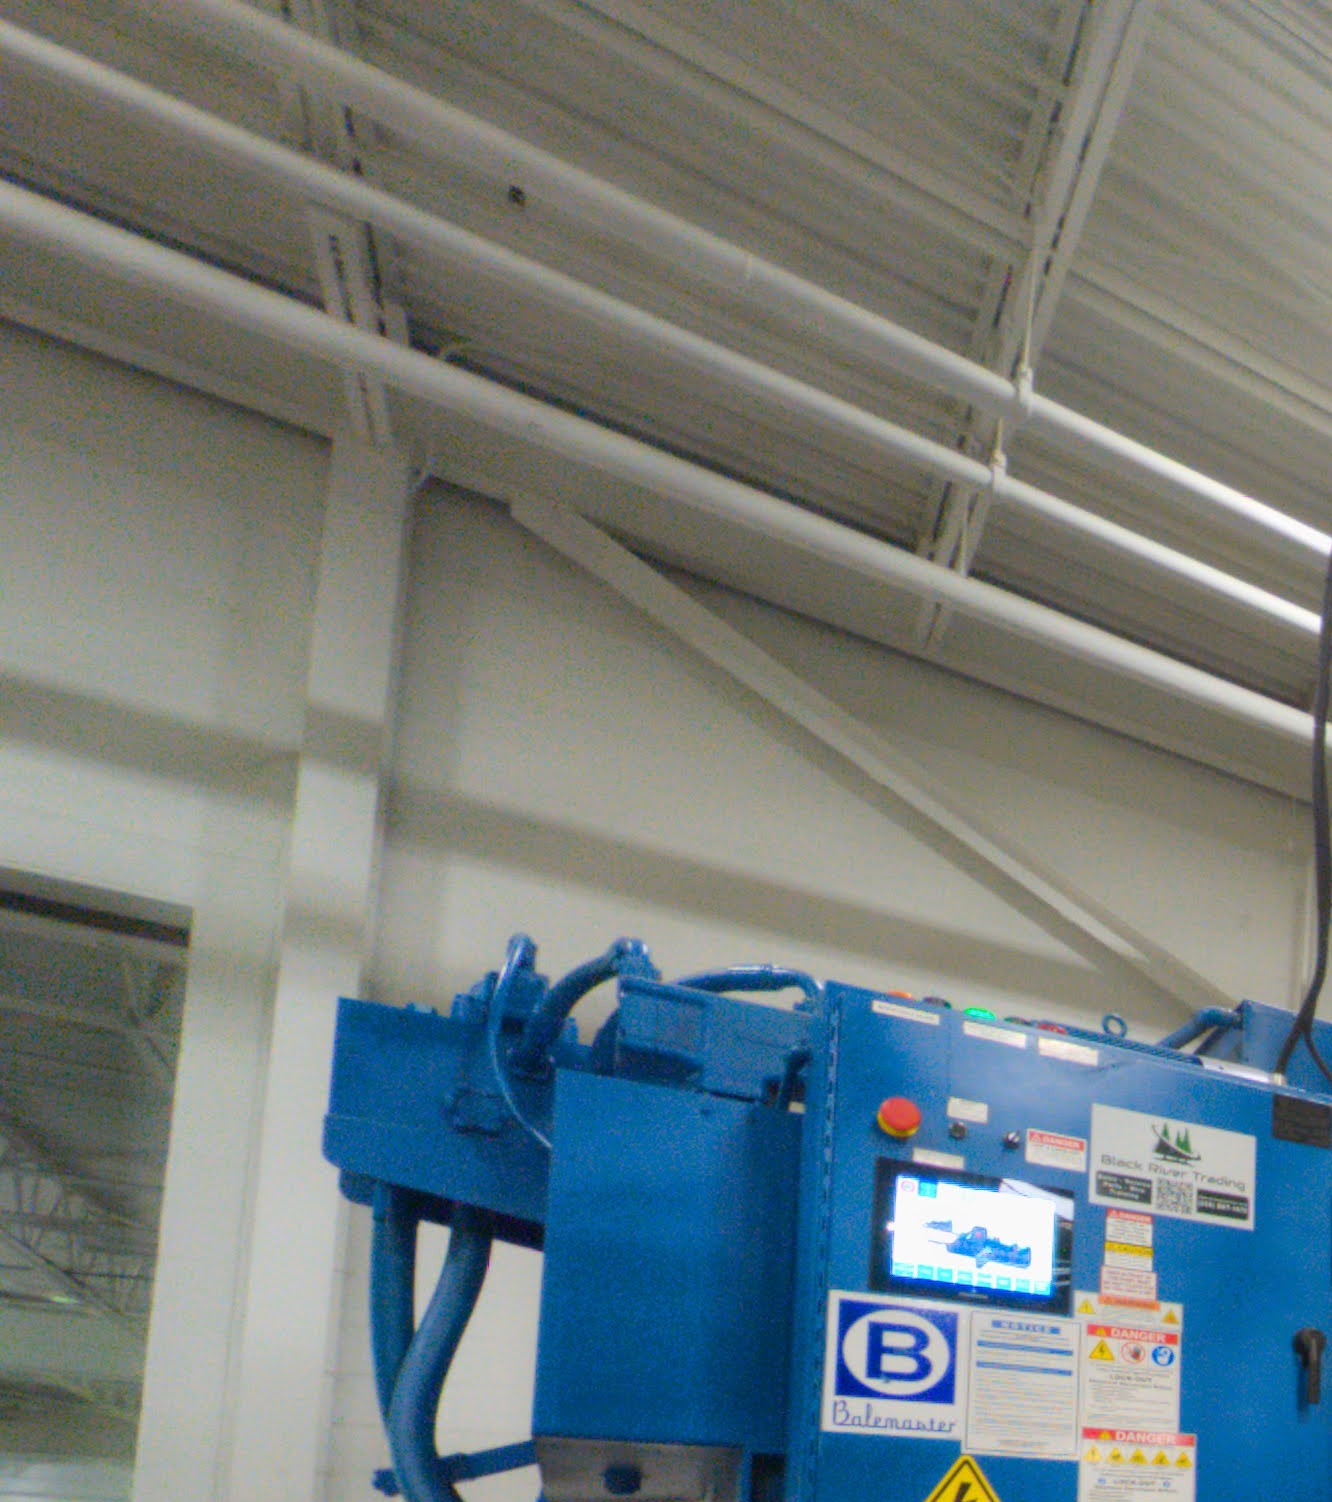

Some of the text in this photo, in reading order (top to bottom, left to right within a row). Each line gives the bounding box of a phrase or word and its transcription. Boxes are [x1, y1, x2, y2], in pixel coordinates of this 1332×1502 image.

[1101, 1154, 1143, 1170] Black
[1149, 1163, 1188, 1178] River
[1192, 1171, 1246, 1192] Trading
[865, 1320, 933, 1382] B
[1110, 1327, 1167, 1344] DANGER
[831, 1400, 956, 1433] Balemaster
[1115, 1431, 1177, 1445] DANGER
